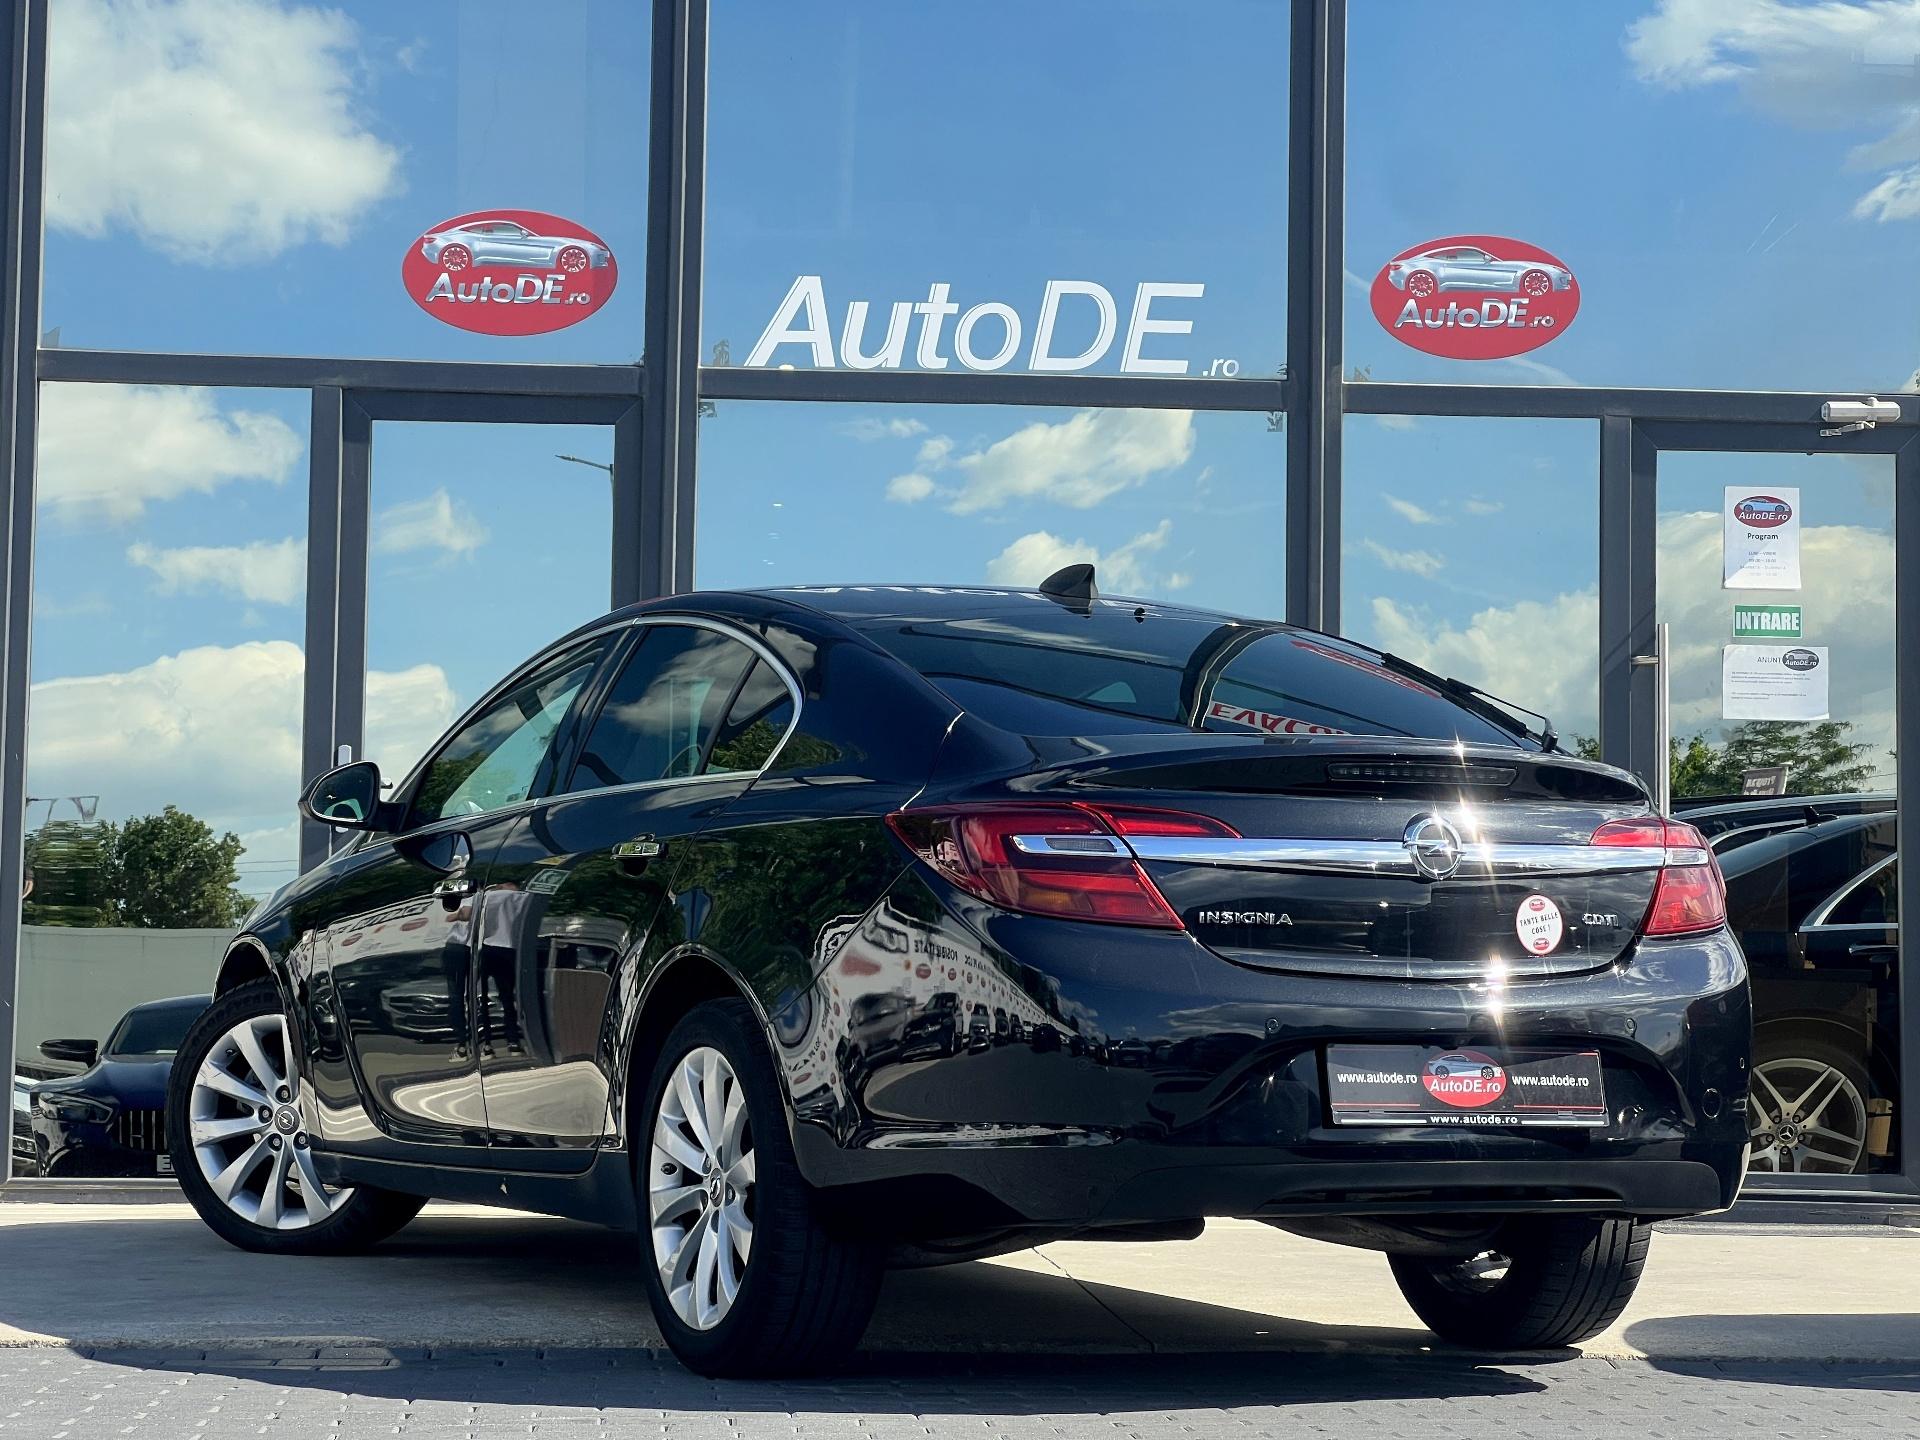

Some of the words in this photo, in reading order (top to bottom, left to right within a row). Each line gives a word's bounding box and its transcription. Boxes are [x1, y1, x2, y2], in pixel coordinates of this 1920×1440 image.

[425, 272, 591, 305] AutoDE.ro
[1394, 298, 1555, 329] AutoDE.ro
[744, 275, 1240, 377] AutoDE.ro
[1738, 511, 1788, 521] AutoDE.ro
[1747, 532, 1779, 541] Program
[1735, 611, 1800, 631] INTRARE
[1199, 911, 1293, 926] INSIGNIA
[1582, 912, 1619, 927] CDTI
[1337, 1071, 1418, 1084] www.autode.ro
[1511, 1074, 1590, 1088] www.autode.ro
[1429, 1078, 1502, 1094] AutoDE.ro
[1430, 1114, 1519, 1126] www.autode.ro
